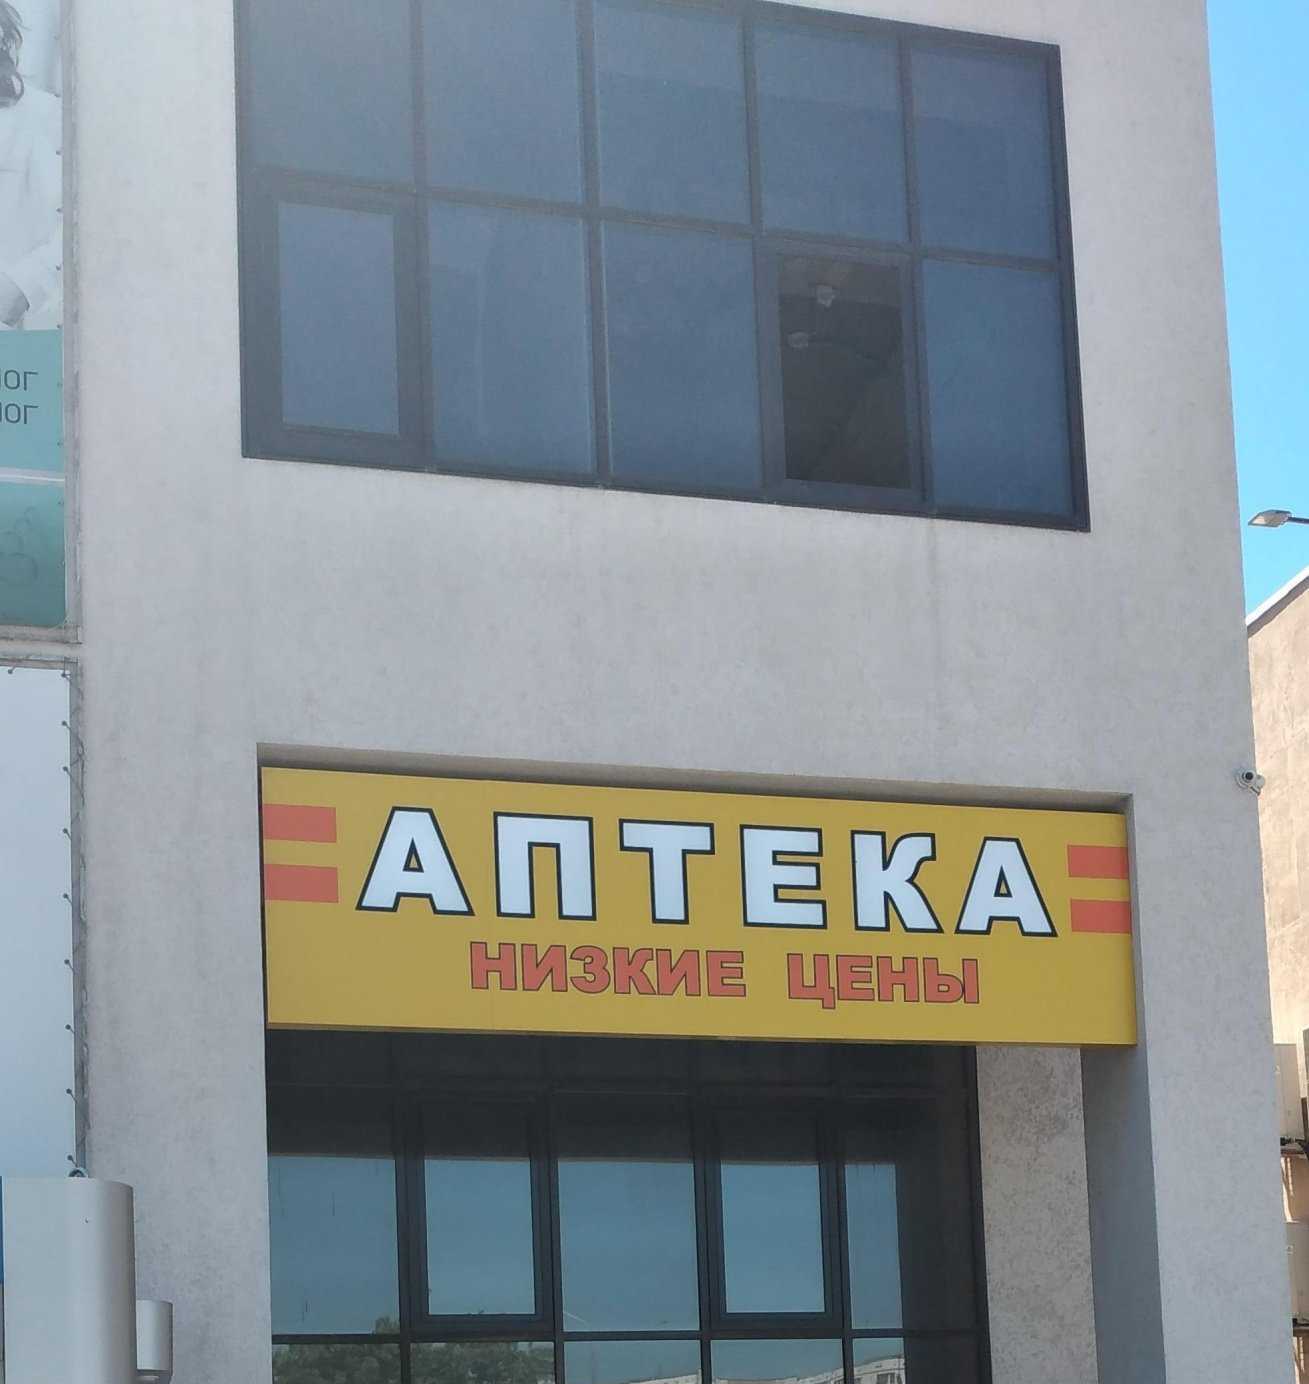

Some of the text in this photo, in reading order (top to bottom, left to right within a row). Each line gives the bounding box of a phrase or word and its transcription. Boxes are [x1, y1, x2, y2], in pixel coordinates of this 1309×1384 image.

[0, 369, 39, 391] ОГ
[0, 402, 39, 425] ОГ
[356, 806, 1058, 937] АПТЕКА
[469, 942, 980, 1010] НИЗКИЕ ЦЕНЫ
